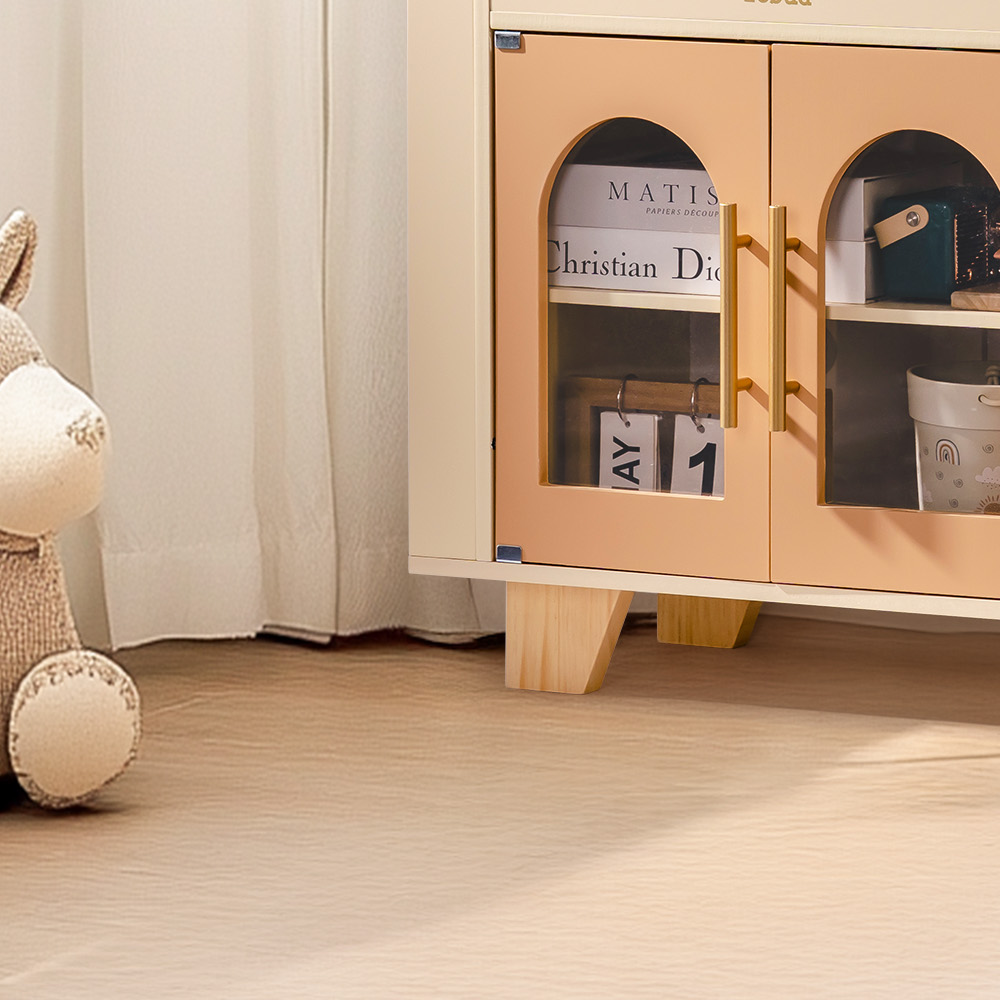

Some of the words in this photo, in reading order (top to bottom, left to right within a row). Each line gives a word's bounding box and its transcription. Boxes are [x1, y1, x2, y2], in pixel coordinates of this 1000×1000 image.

[607, 181, 719, 206] MATIS
[645, 207, 681, 216] PAPIERS
[548, 239, 657, 279] Christian
[611, 436, 640, 491] AY
[688, 442, 717, 496] 1
